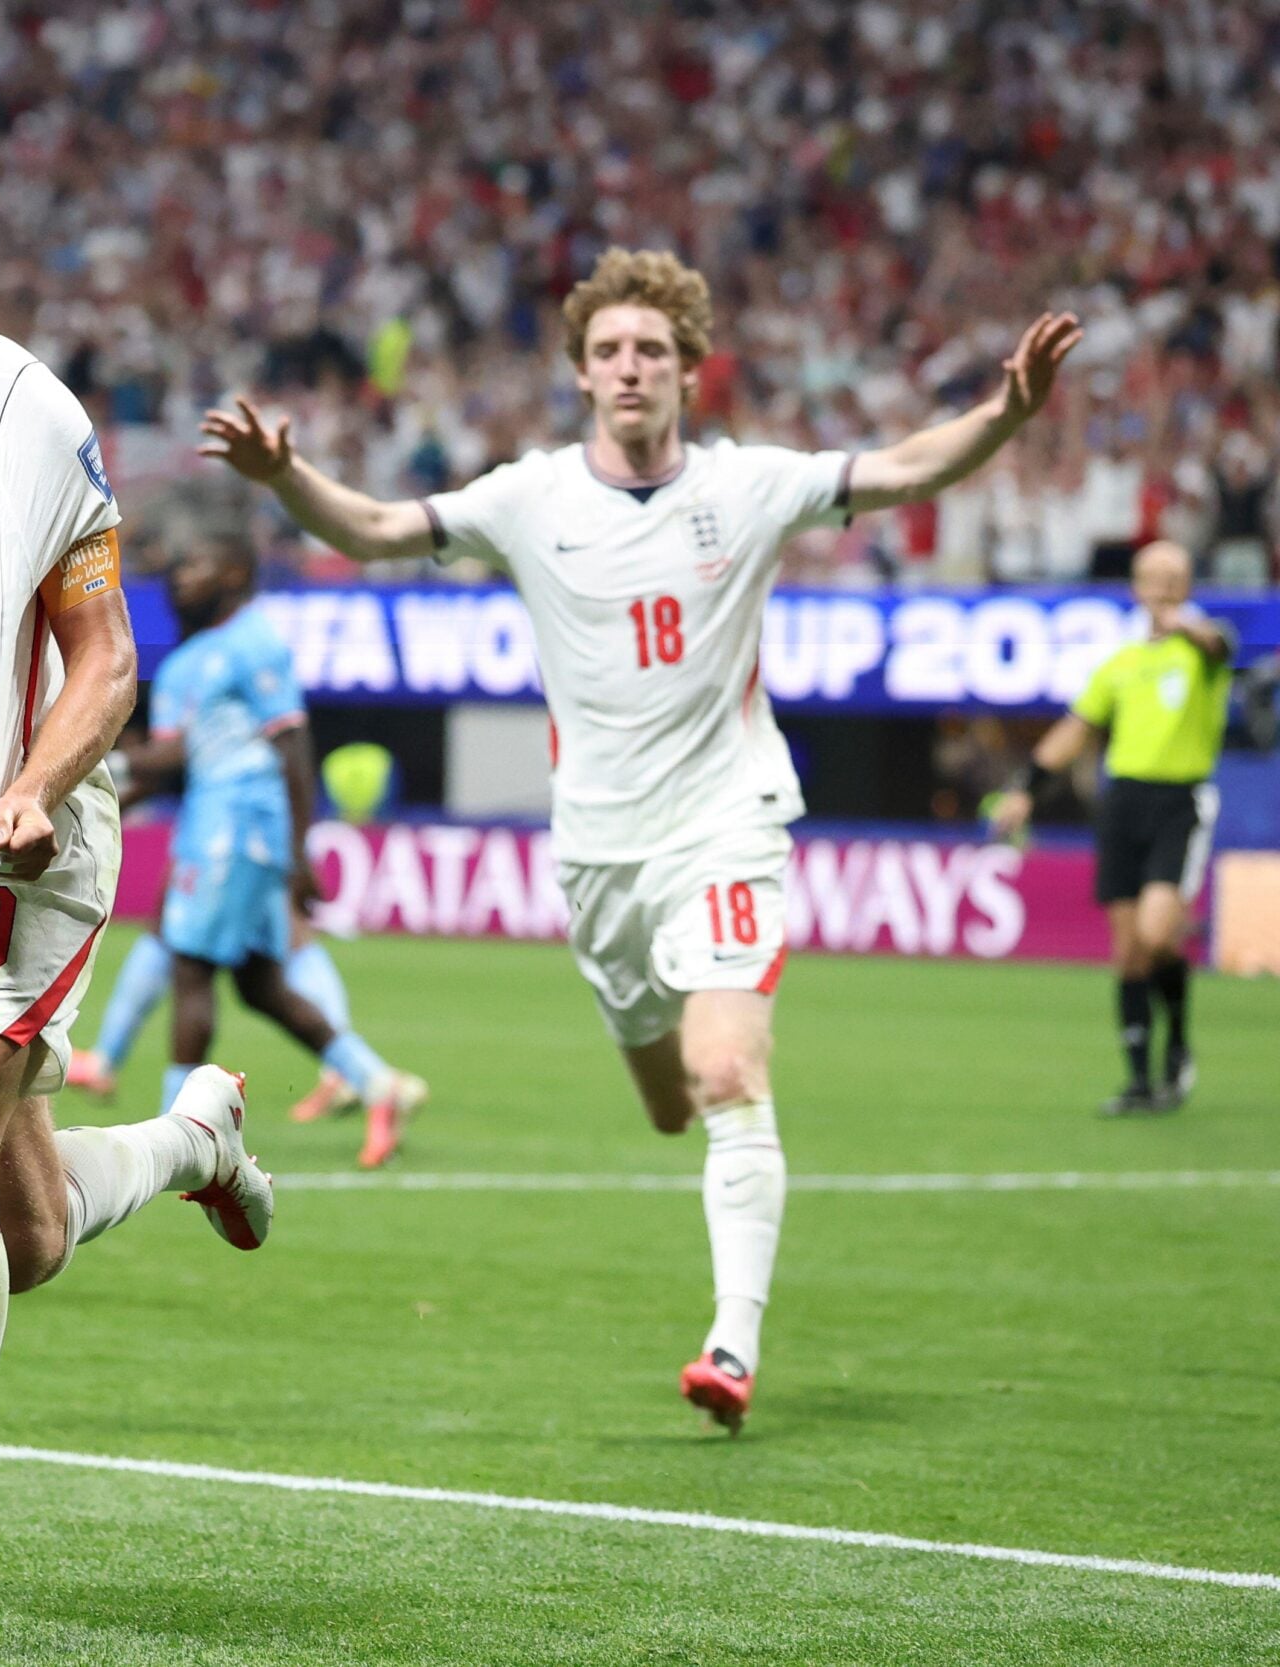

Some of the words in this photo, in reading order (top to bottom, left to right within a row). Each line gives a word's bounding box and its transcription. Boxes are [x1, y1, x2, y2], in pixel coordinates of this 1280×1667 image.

[60, 539, 110, 573] UNITES
[62, 573, 83, 590] the
[83, 555, 114, 578] World
[85, 578, 106, 592] FIFA
[628, 596, 684, 669] 18
[760, 597, 884, 699] UP
[705, 881, 758, 946] 18
[783, 840, 1026, 957] WAYS
